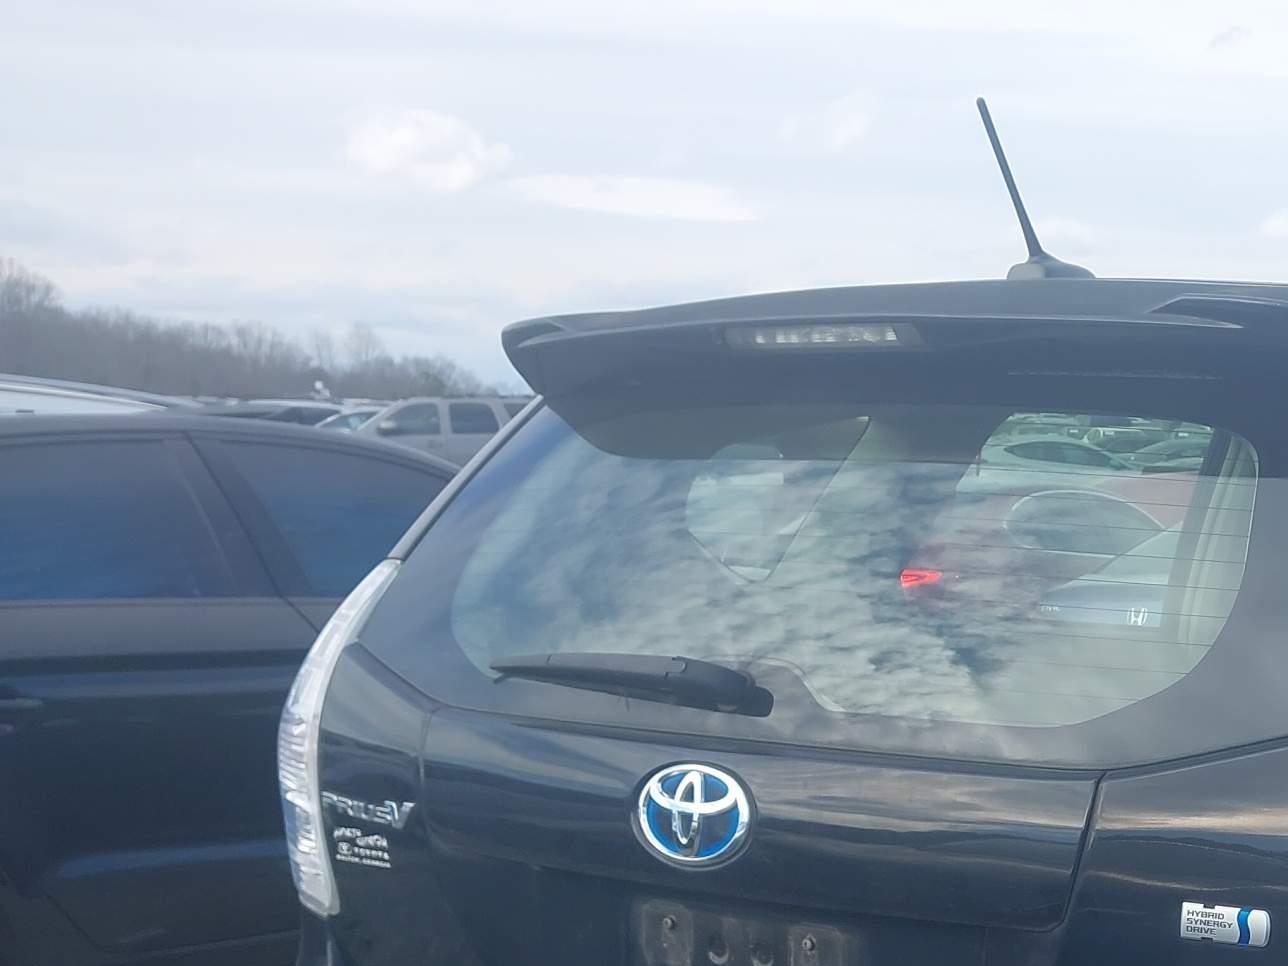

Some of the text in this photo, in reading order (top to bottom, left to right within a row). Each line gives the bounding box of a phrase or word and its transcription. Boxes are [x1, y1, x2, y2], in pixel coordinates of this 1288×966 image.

[1186, 909, 1225, 920] HYBRID
[1186, 917, 1234, 929] SYNERGY
[1186, 925, 1217, 935] DRIVE
